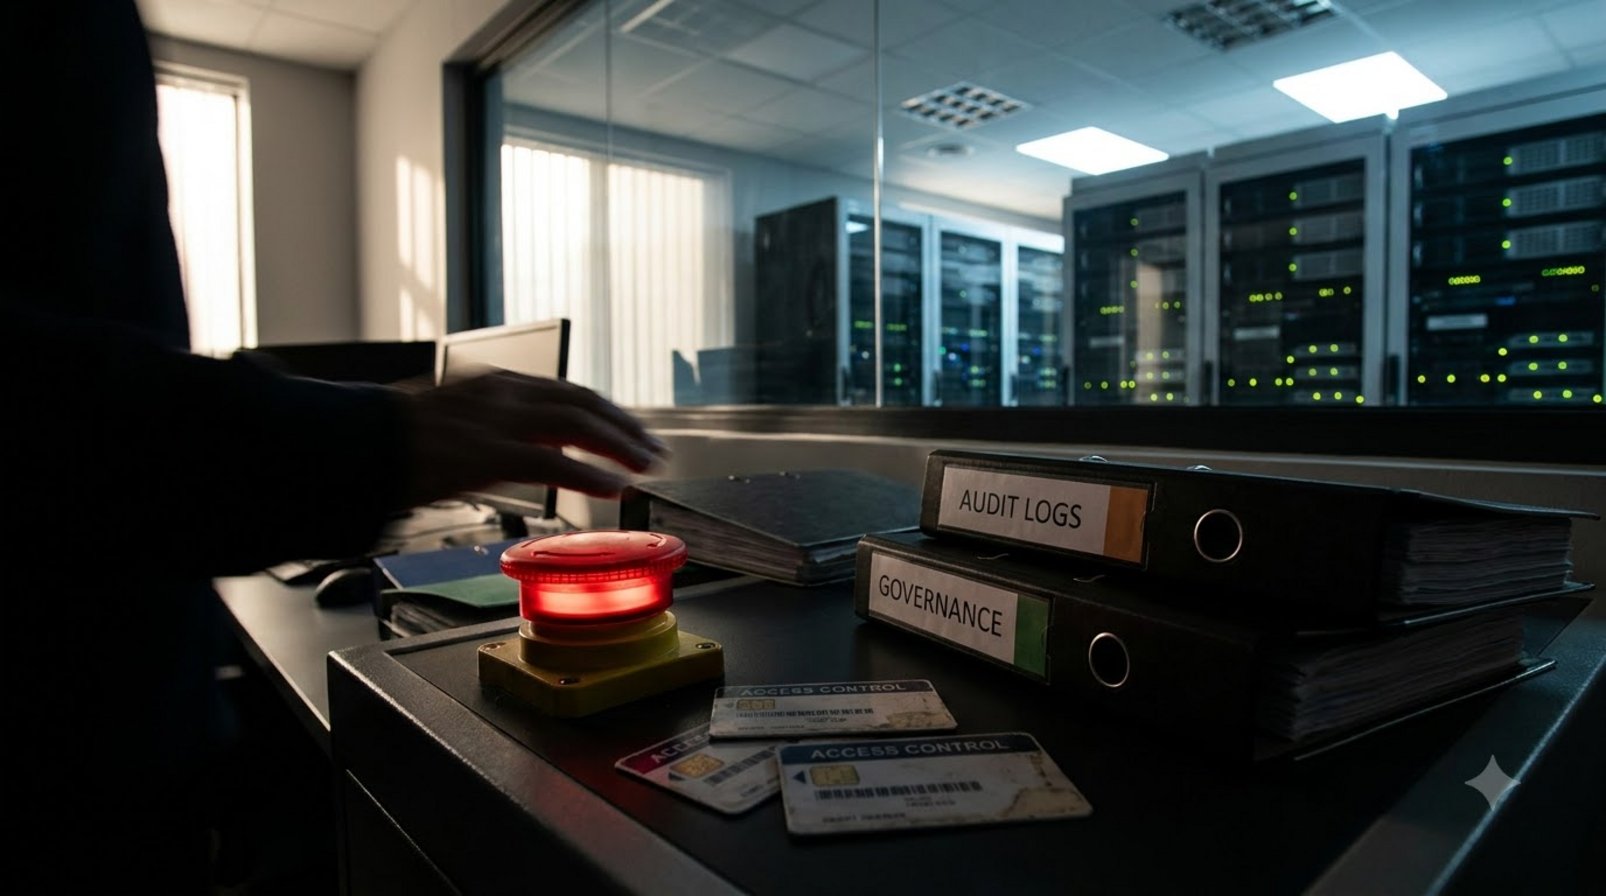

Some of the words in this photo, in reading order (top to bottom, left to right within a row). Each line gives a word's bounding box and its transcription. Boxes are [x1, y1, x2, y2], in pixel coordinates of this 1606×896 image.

[959, 489, 1019, 519] AUDIT
[1024, 498, 1082, 529] LOGS
[879, 574, 1003, 637] GOVERNANCE
[740, 686, 814, 697] ACCESS
[819, 683, 907, 694] CONTROL
[811, 745, 900, 760] ACCESS
[904, 740, 1010, 755] CONTROL
